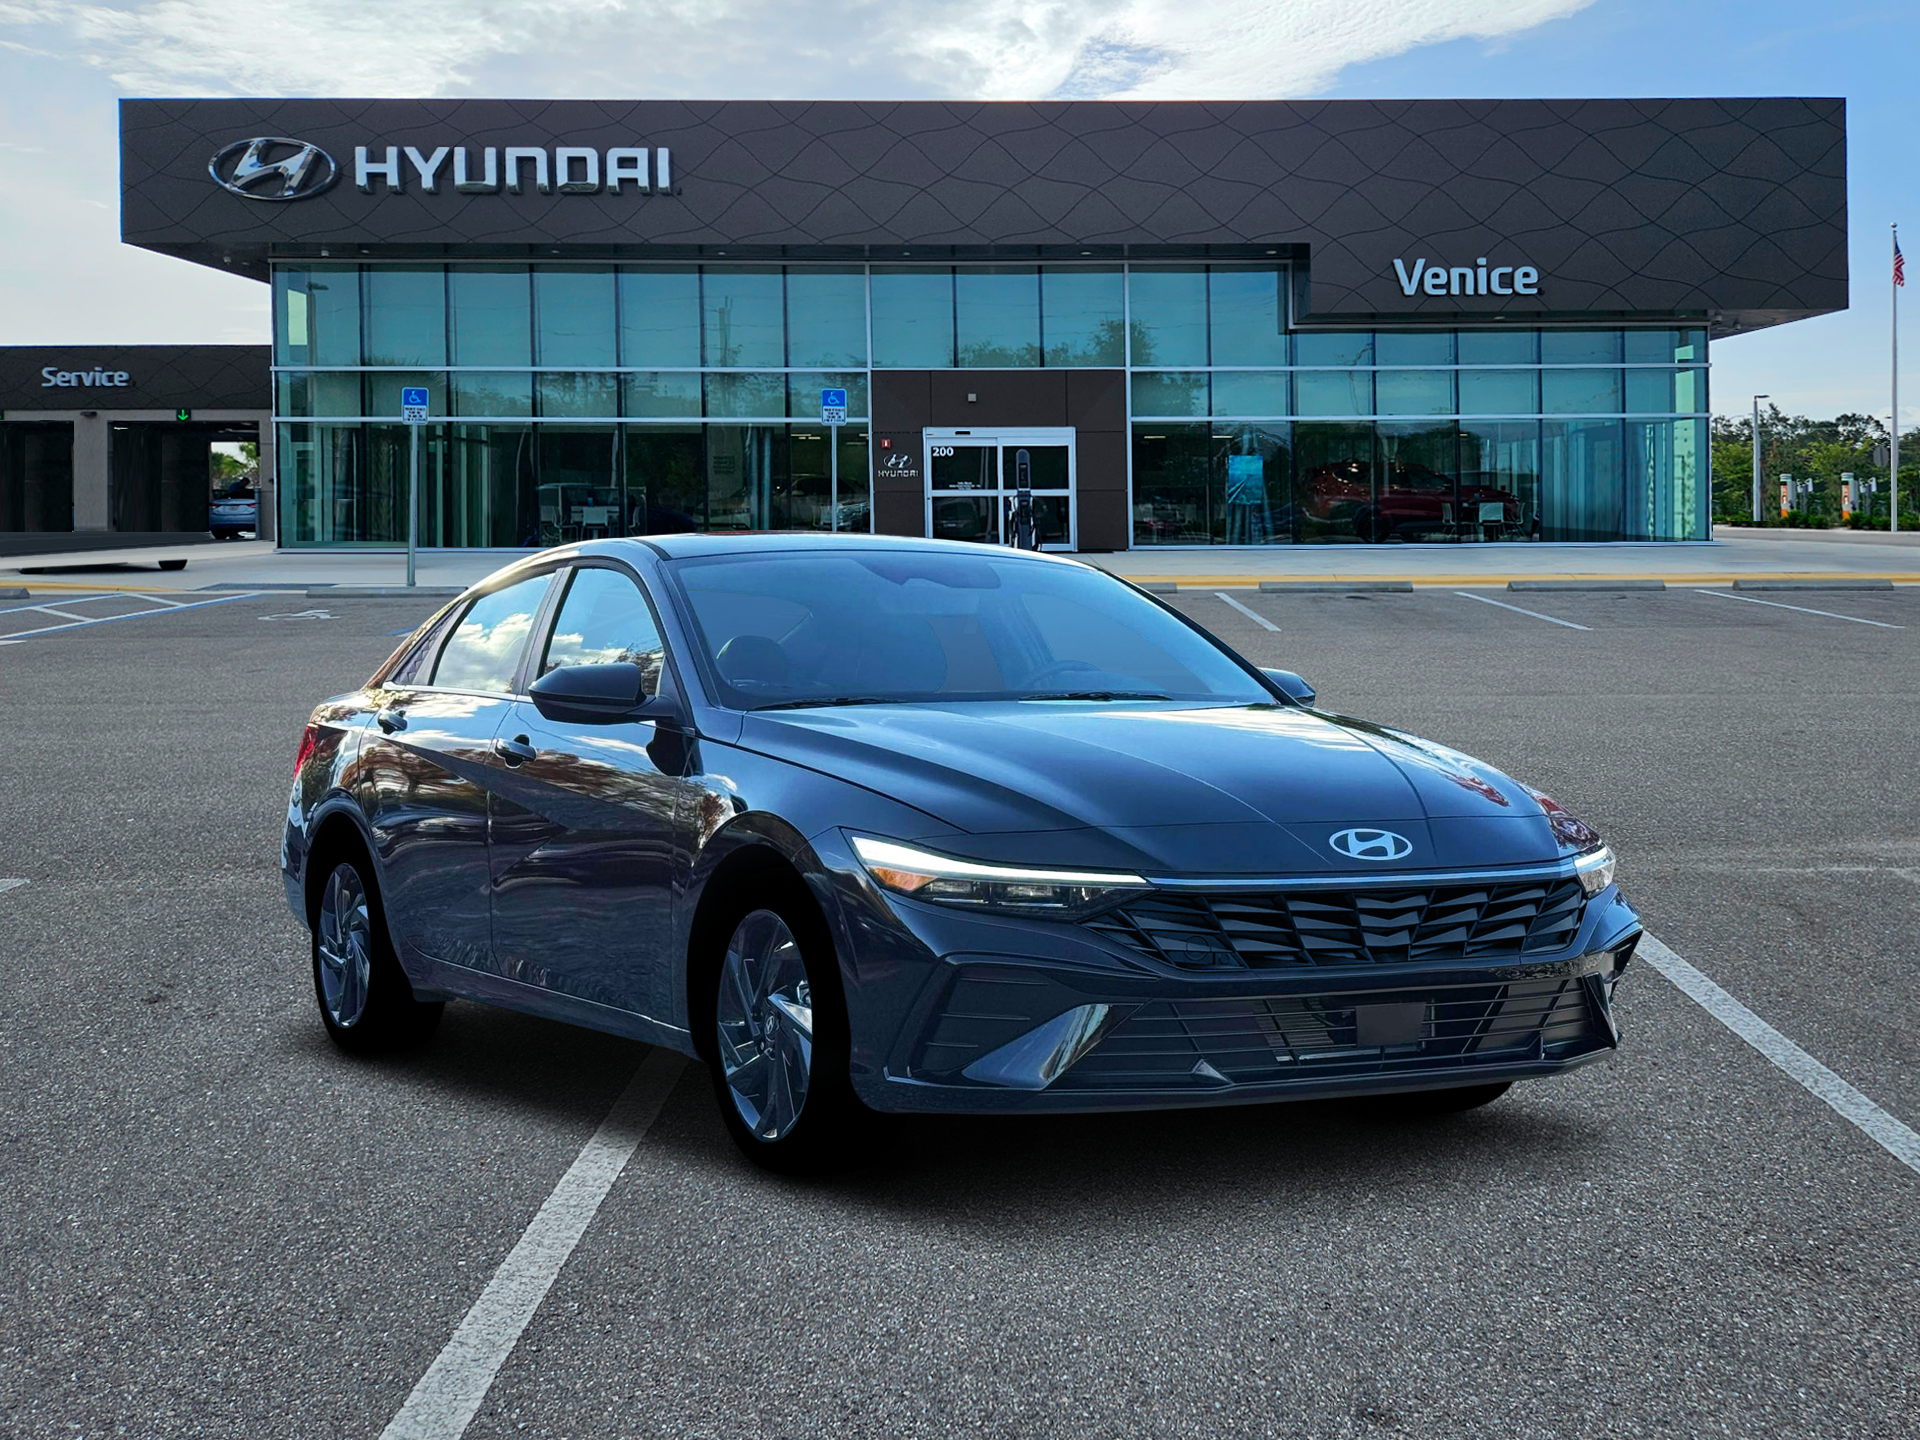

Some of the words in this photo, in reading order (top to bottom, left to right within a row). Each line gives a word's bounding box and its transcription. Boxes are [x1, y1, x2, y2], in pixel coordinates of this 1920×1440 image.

[355, 146, 670, 195] HYUNDAI
[1393, 257, 1539, 295] Venice
[41, 367, 129, 386] Service
[932, 447, 954, 457] 200
[878, 470, 919, 478] HYUNDAI
